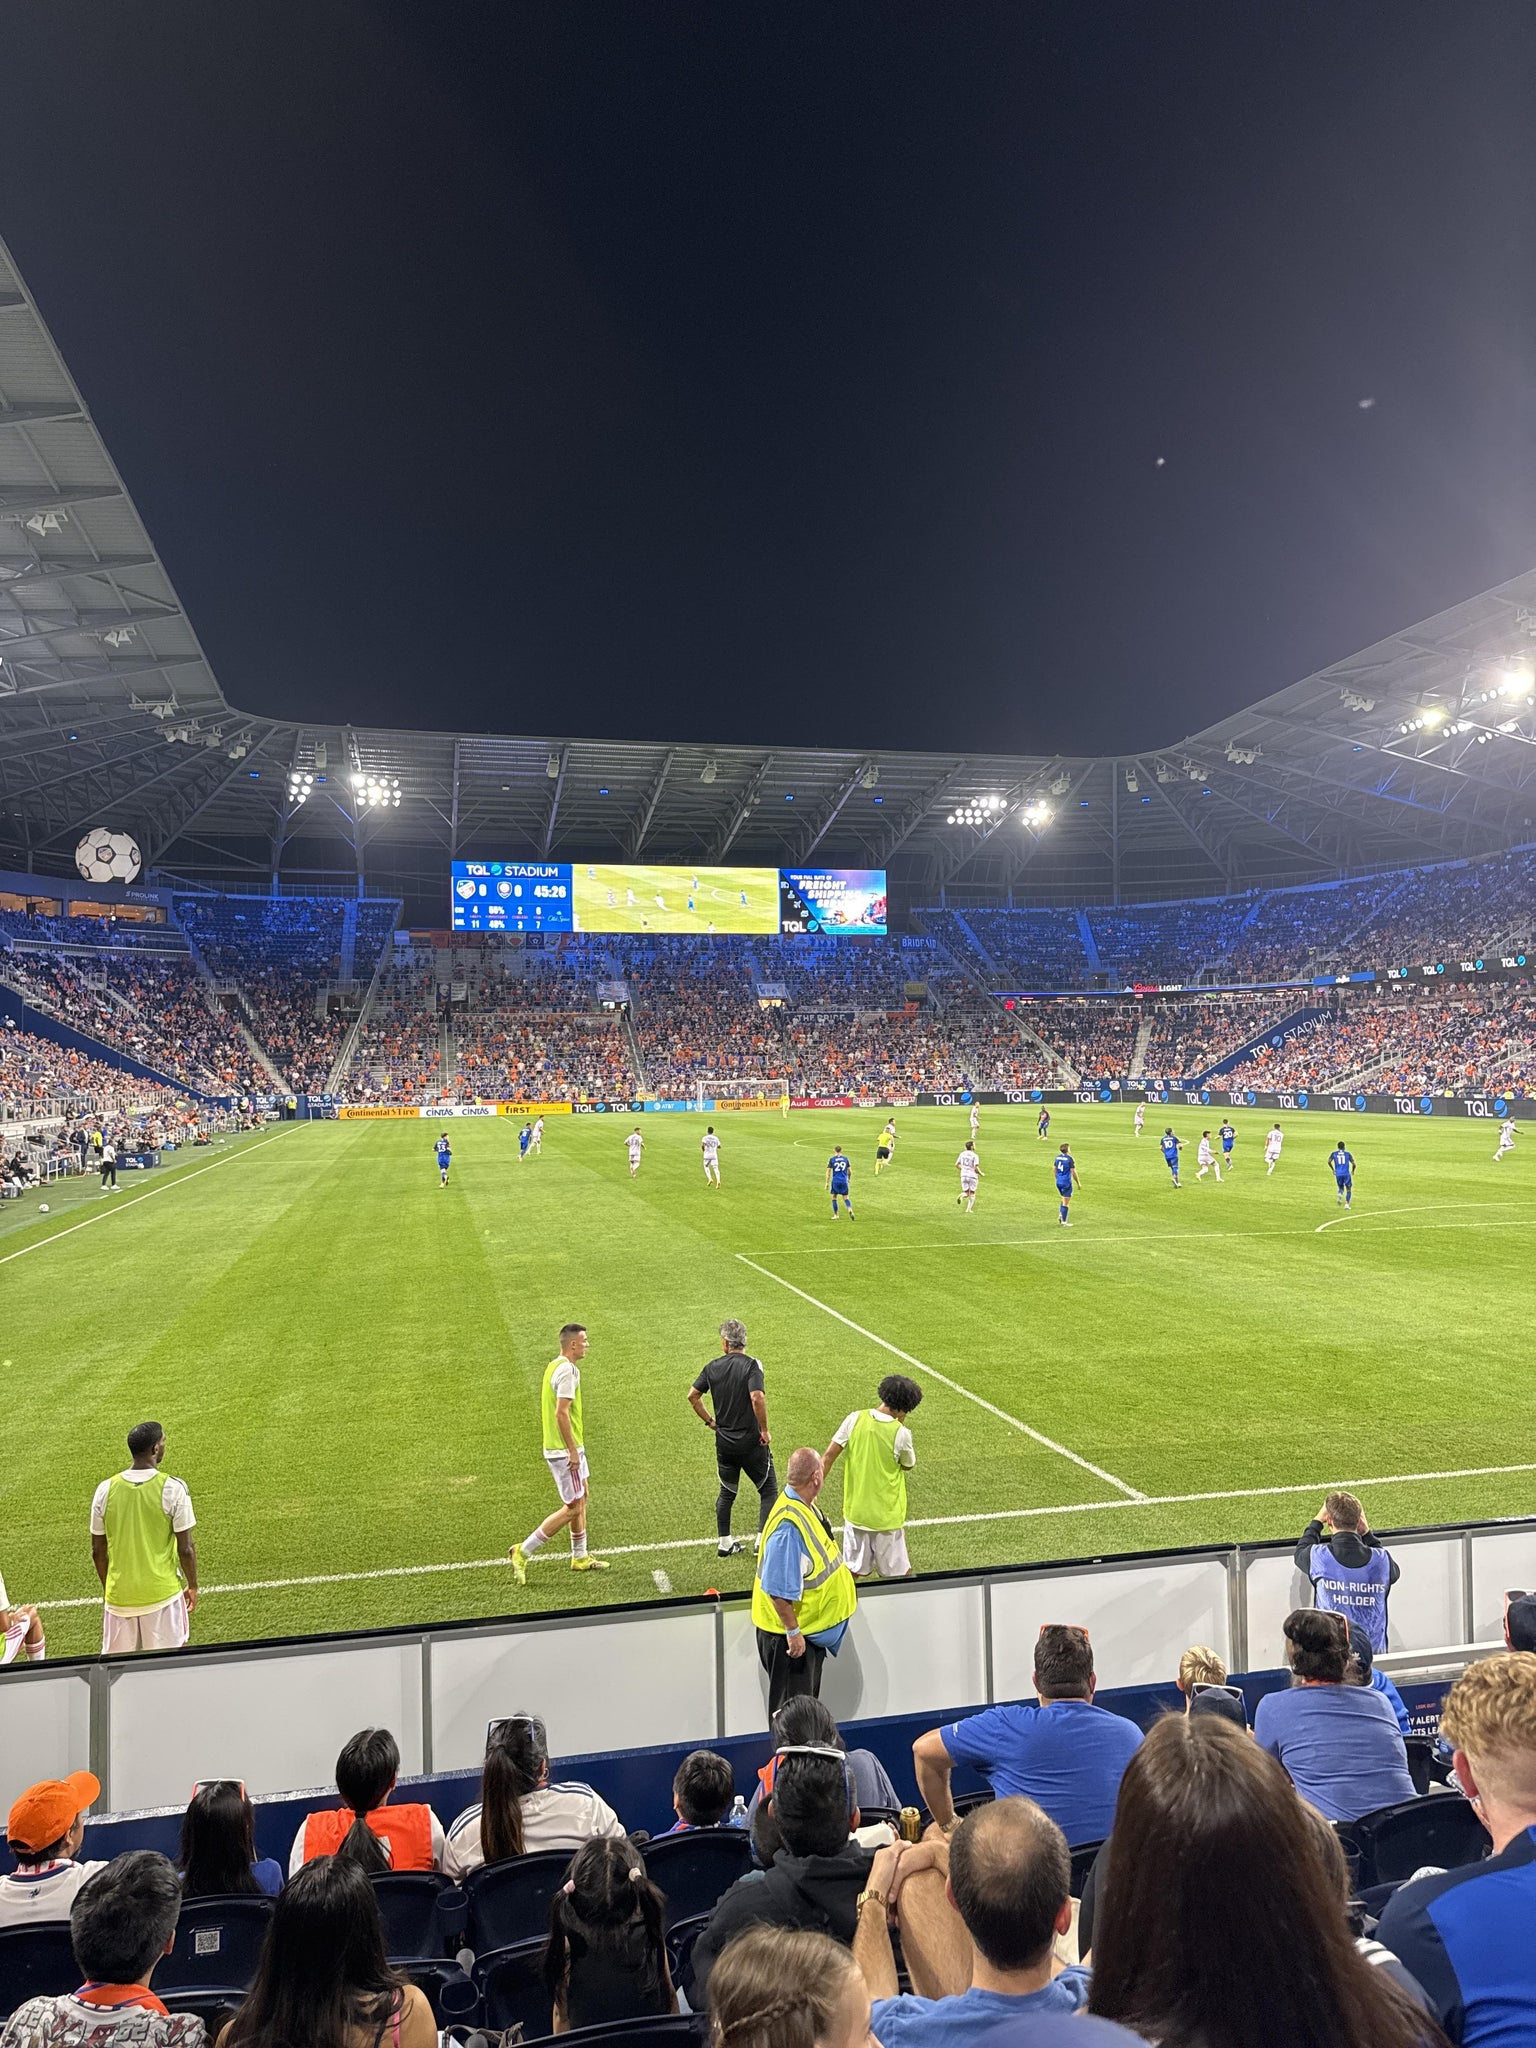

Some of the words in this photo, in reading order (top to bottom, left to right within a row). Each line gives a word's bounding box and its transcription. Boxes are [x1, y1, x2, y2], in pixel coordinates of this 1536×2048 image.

[466, 864, 490, 876] TQL
[505, 866, 558, 877] STADIUM
[479, 884, 487, 896] 0
[799, 880, 846, 890] FREIGHT
[514, 885, 522, 897] 0
[782, 920, 807, 933] TQL
[1460, 961, 1476, 972] TQL
[1501, 957, 1518, 968] TQL
[1387, 970, 1401, 979] TQL
[1422, 966, 1438, 975] TQL
[1283, 1010, 1332, 1042] STADIUM
[256, 1096, 268, 1104] TQL
[307, 1095, 322, 1103] TQL
[933, 1094, 959, 1105] TQL
[1004, 1090, 1030, 1103] TQL
[1073, 1091, 1099, 1103] TQL
[1145, 1091, 1159, 1103] TQL
[1185, 1092, 1202, 1104] TQL
[1229, 1092, 1247, 1105] TQL
[1277, 1095, 1298, 1109] TQL
[574, 1103, 595, 1113] TQL
[610, 1103, 631, 1112] TQL
[720, 1100, 758, 1109] Continental
[1332, 1096, 1355, 1111] TQL
[1394, 1098, 1420, 1114] TQL
[1464, 1100, 1493, 1117] TQL
[347, 1109, 389, 1118] Continental
[398, 1108, 415, 1116] Tire
[1223, 1130, 1232, 1138] 20
[1163, 1140, 1173, 1148] 10
[1336, 1155, 1345, 1165] 11
[833, 1161, 846, 1172] 29
[1057, 1160, 1064, 1172] 4
[1322, 1578, 1385, 1594] NON-RIGHTS
[1333, 1594, 1375, 1607] HOLDER
[1416, 1714, 1439, 1725] ALERT
